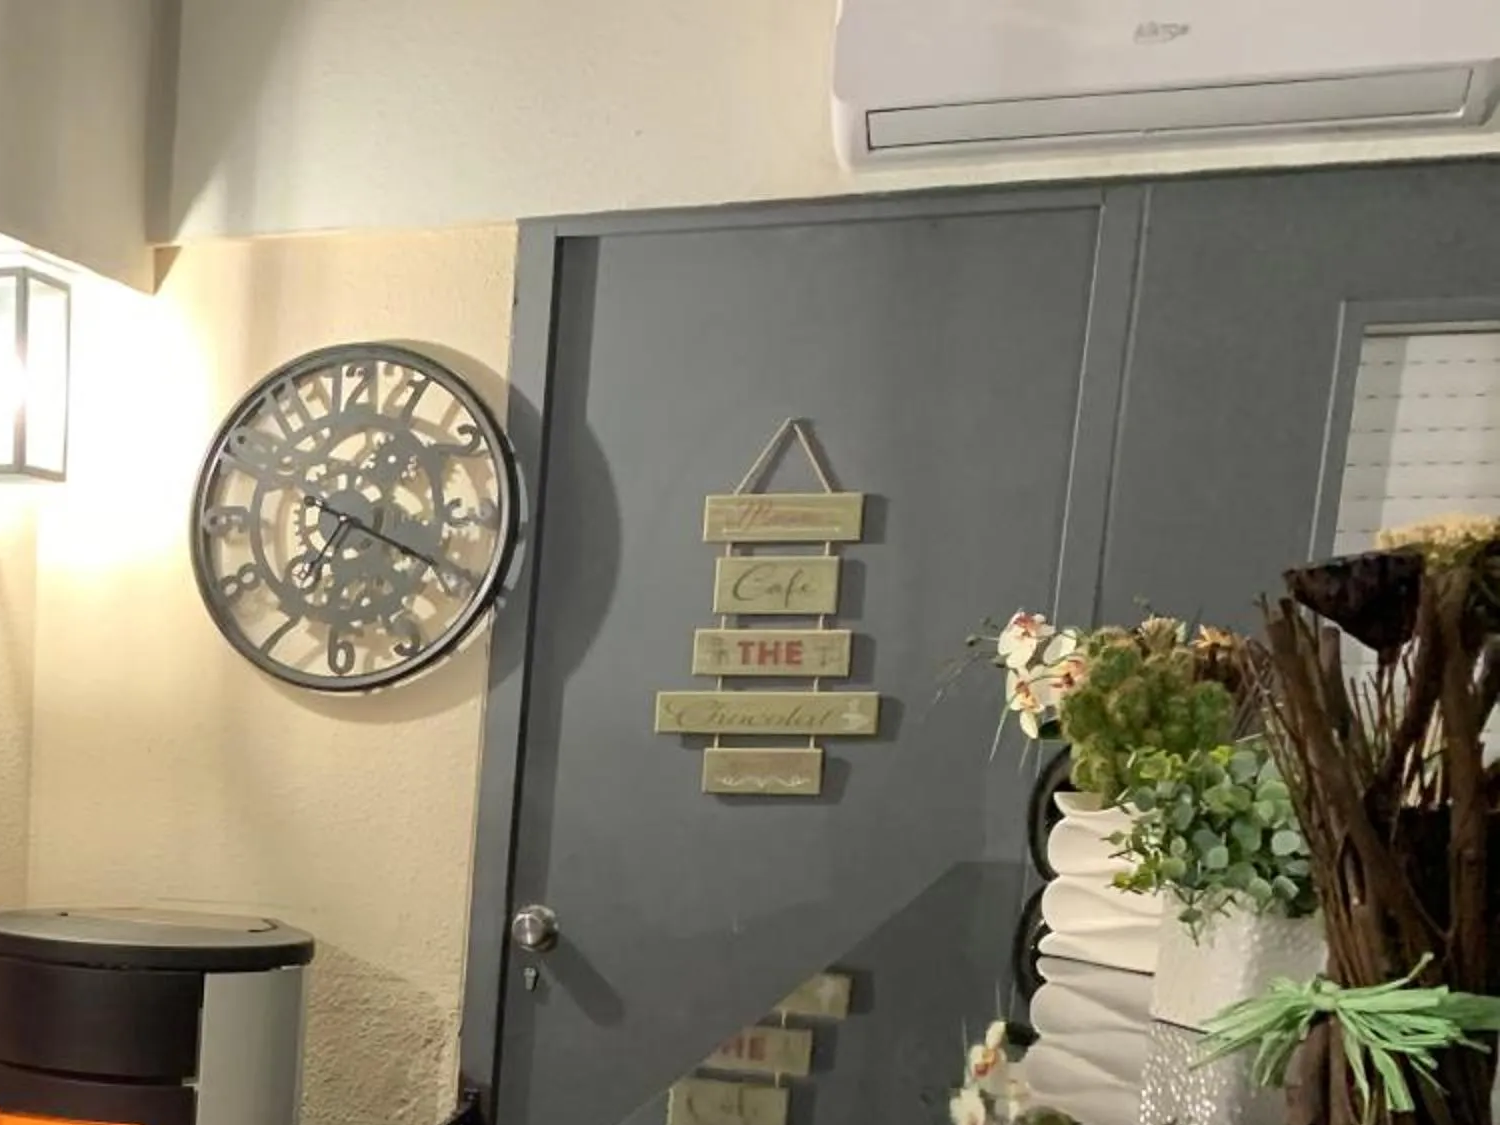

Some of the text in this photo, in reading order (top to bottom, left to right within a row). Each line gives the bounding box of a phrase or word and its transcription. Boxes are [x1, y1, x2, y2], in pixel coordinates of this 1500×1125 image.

[322, 364, 378, 413] 12
[210, 563, 262, 602] 8
[327, 622, 356, 675] 6
[738, 640, 803, 665] THE
